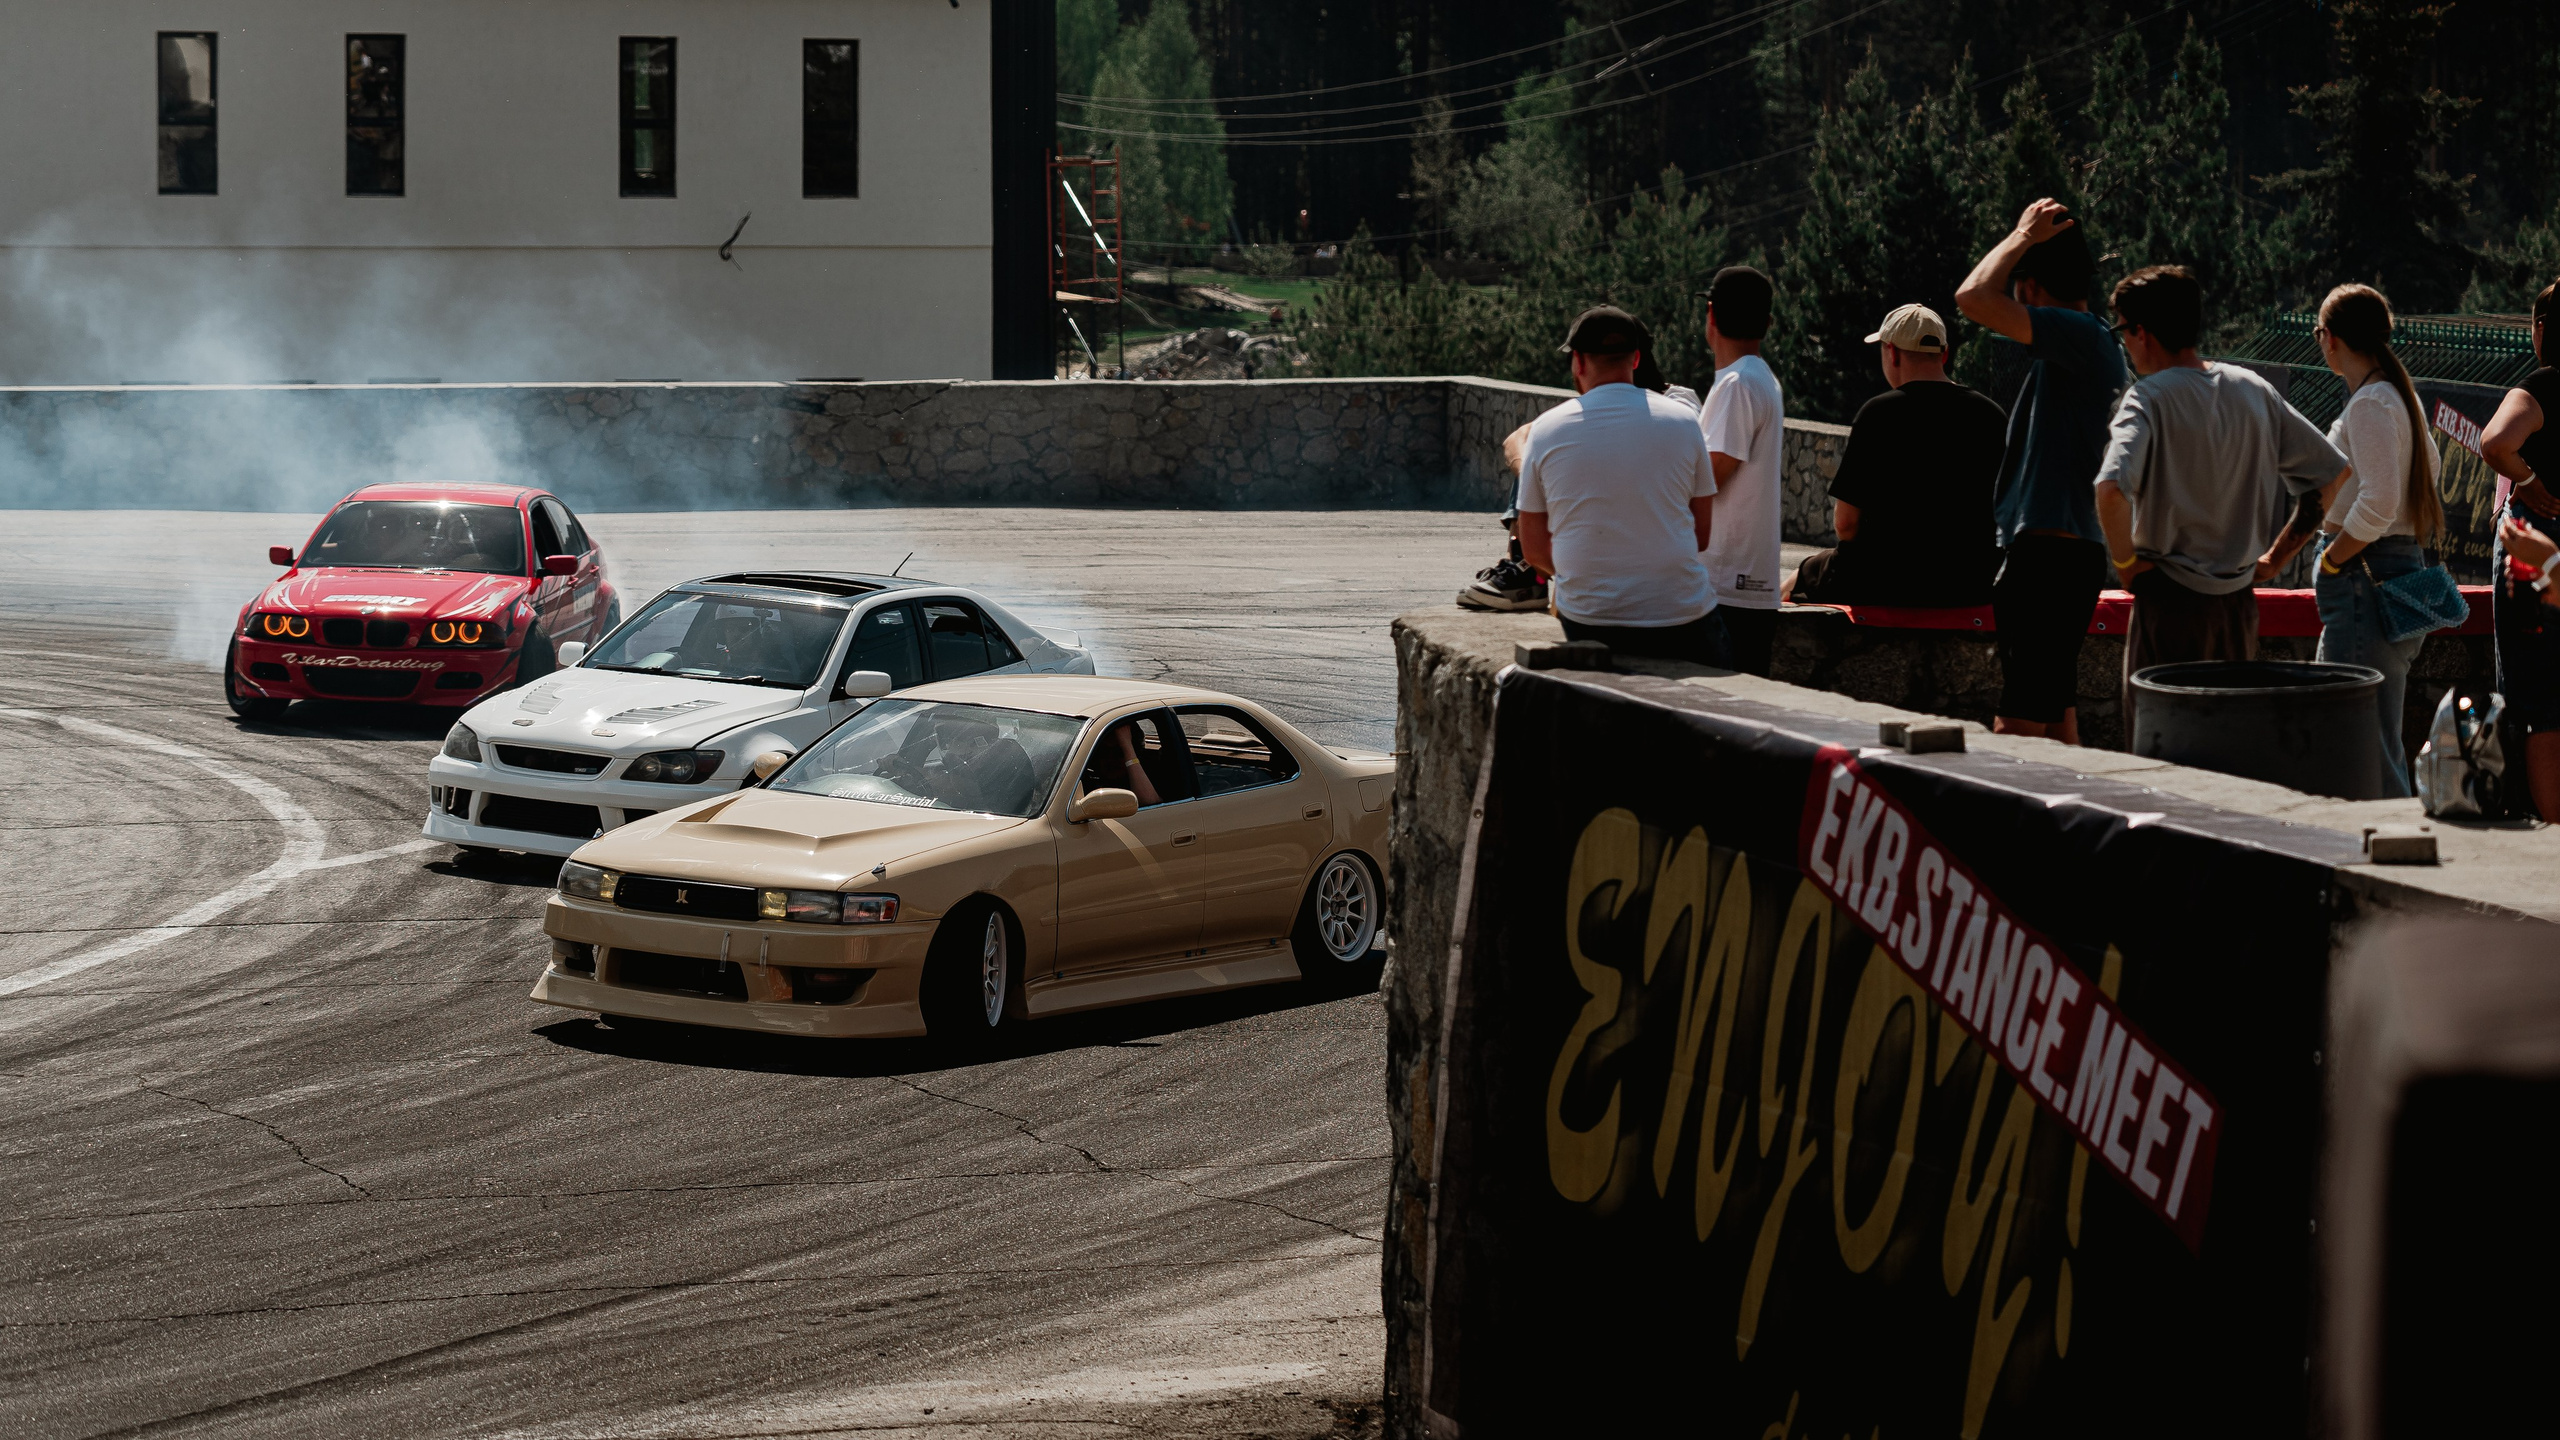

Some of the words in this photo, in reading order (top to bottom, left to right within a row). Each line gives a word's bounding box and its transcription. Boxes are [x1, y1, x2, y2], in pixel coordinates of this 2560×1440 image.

[2436, 401, 2483, 453] EKB.STAN
[2464, 540, 2493, 558] even
[1810, 762, 2214, 1221] EKB.STANCE.MEET
